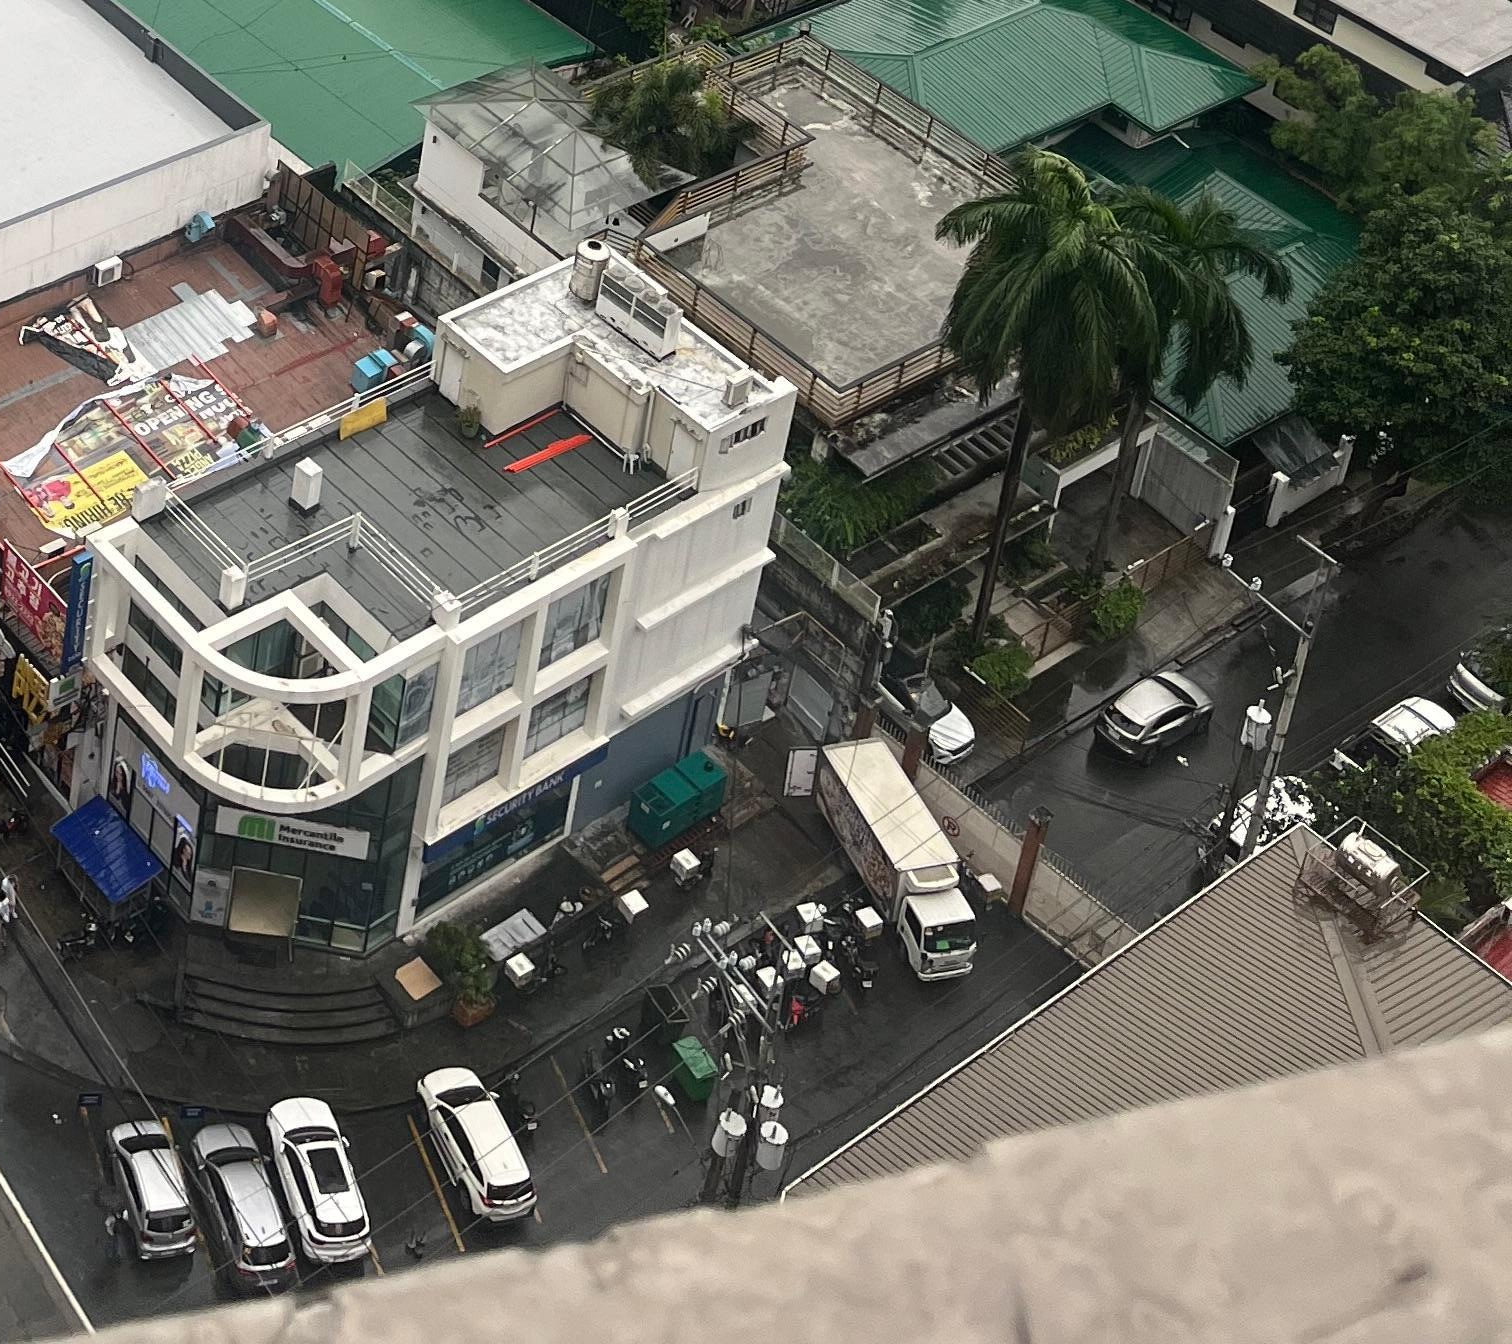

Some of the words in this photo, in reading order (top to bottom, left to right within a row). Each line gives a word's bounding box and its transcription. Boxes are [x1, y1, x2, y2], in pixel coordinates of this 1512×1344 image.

[485, 784, 536, 826] SECURITY
[534, 774, 565, 797] BANK
[277, 834, 337, 852] Insurance
[279, 823, 345, 845] Mercantile
